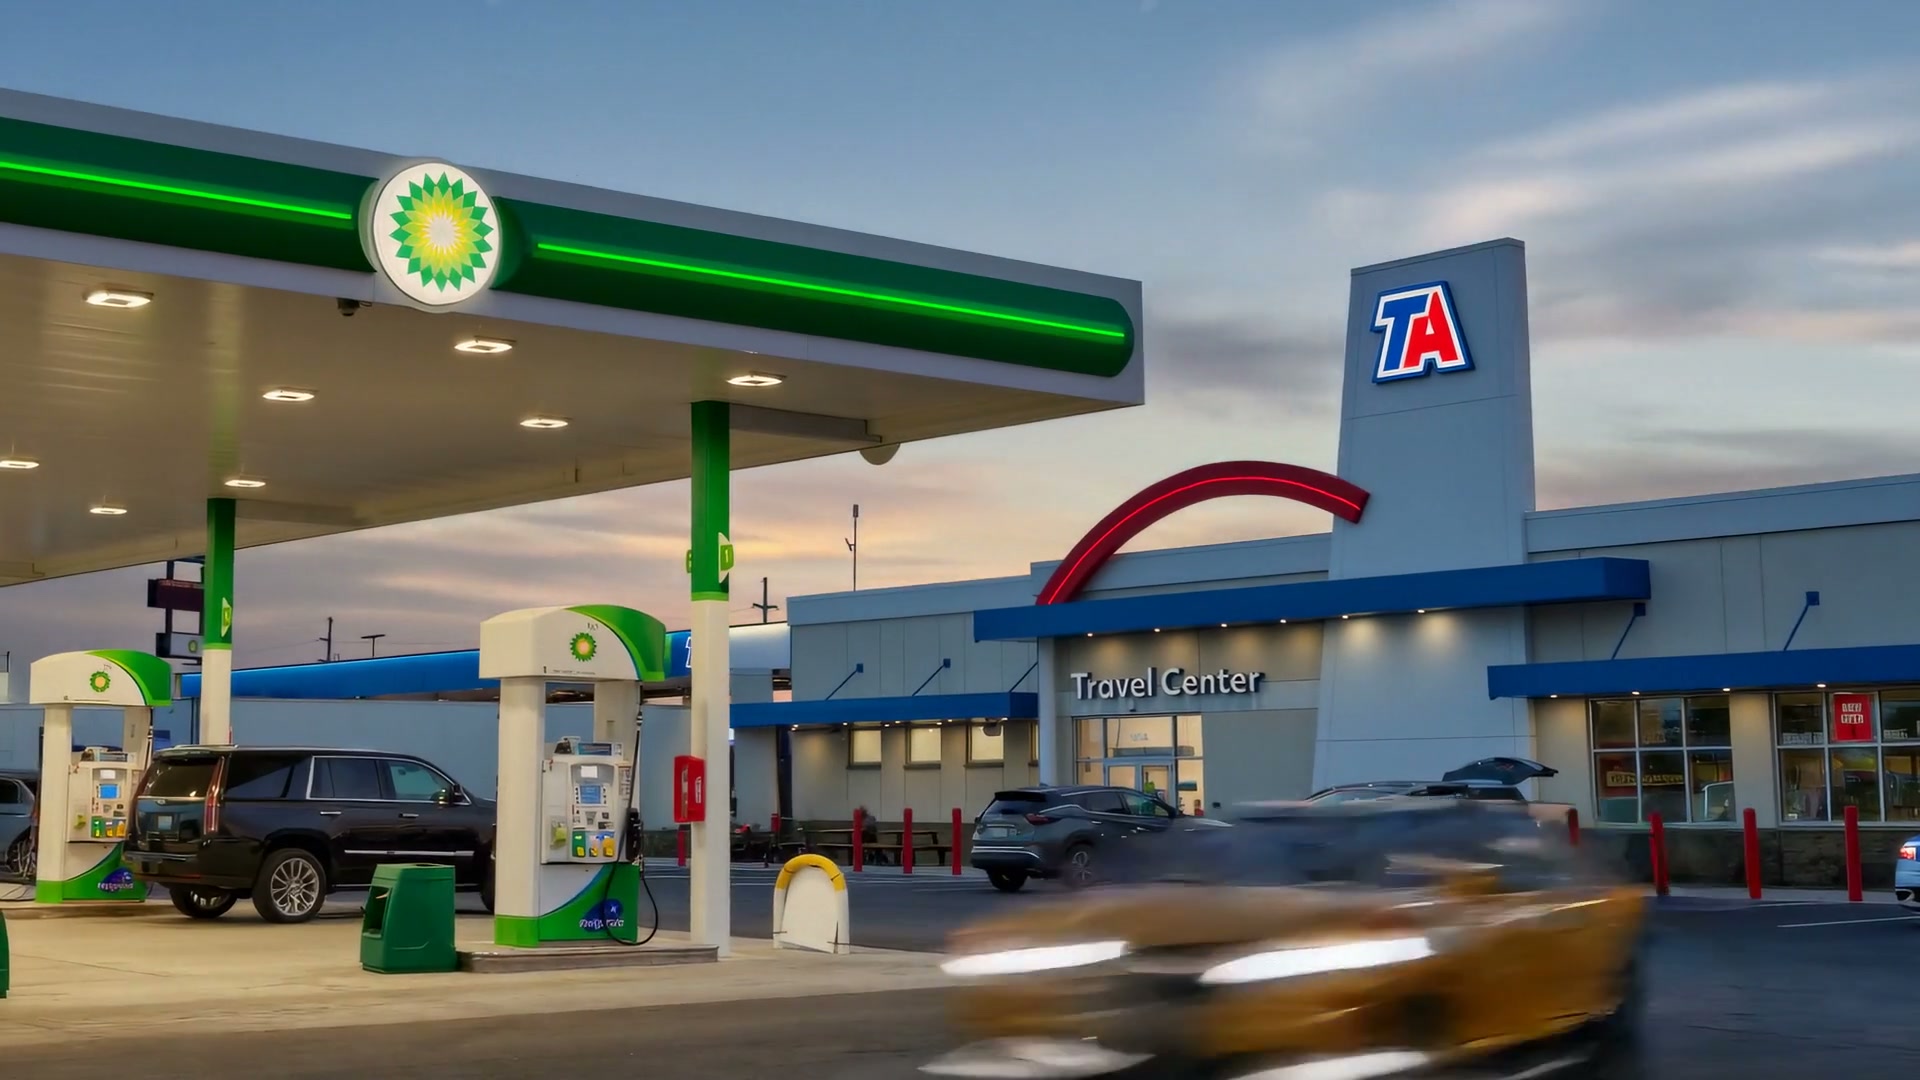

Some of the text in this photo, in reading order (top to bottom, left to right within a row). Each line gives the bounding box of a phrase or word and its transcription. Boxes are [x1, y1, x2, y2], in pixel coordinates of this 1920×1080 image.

[1373, 284, 1467, 380] TA
[1070, 667, 1262, 700] Travel Center
